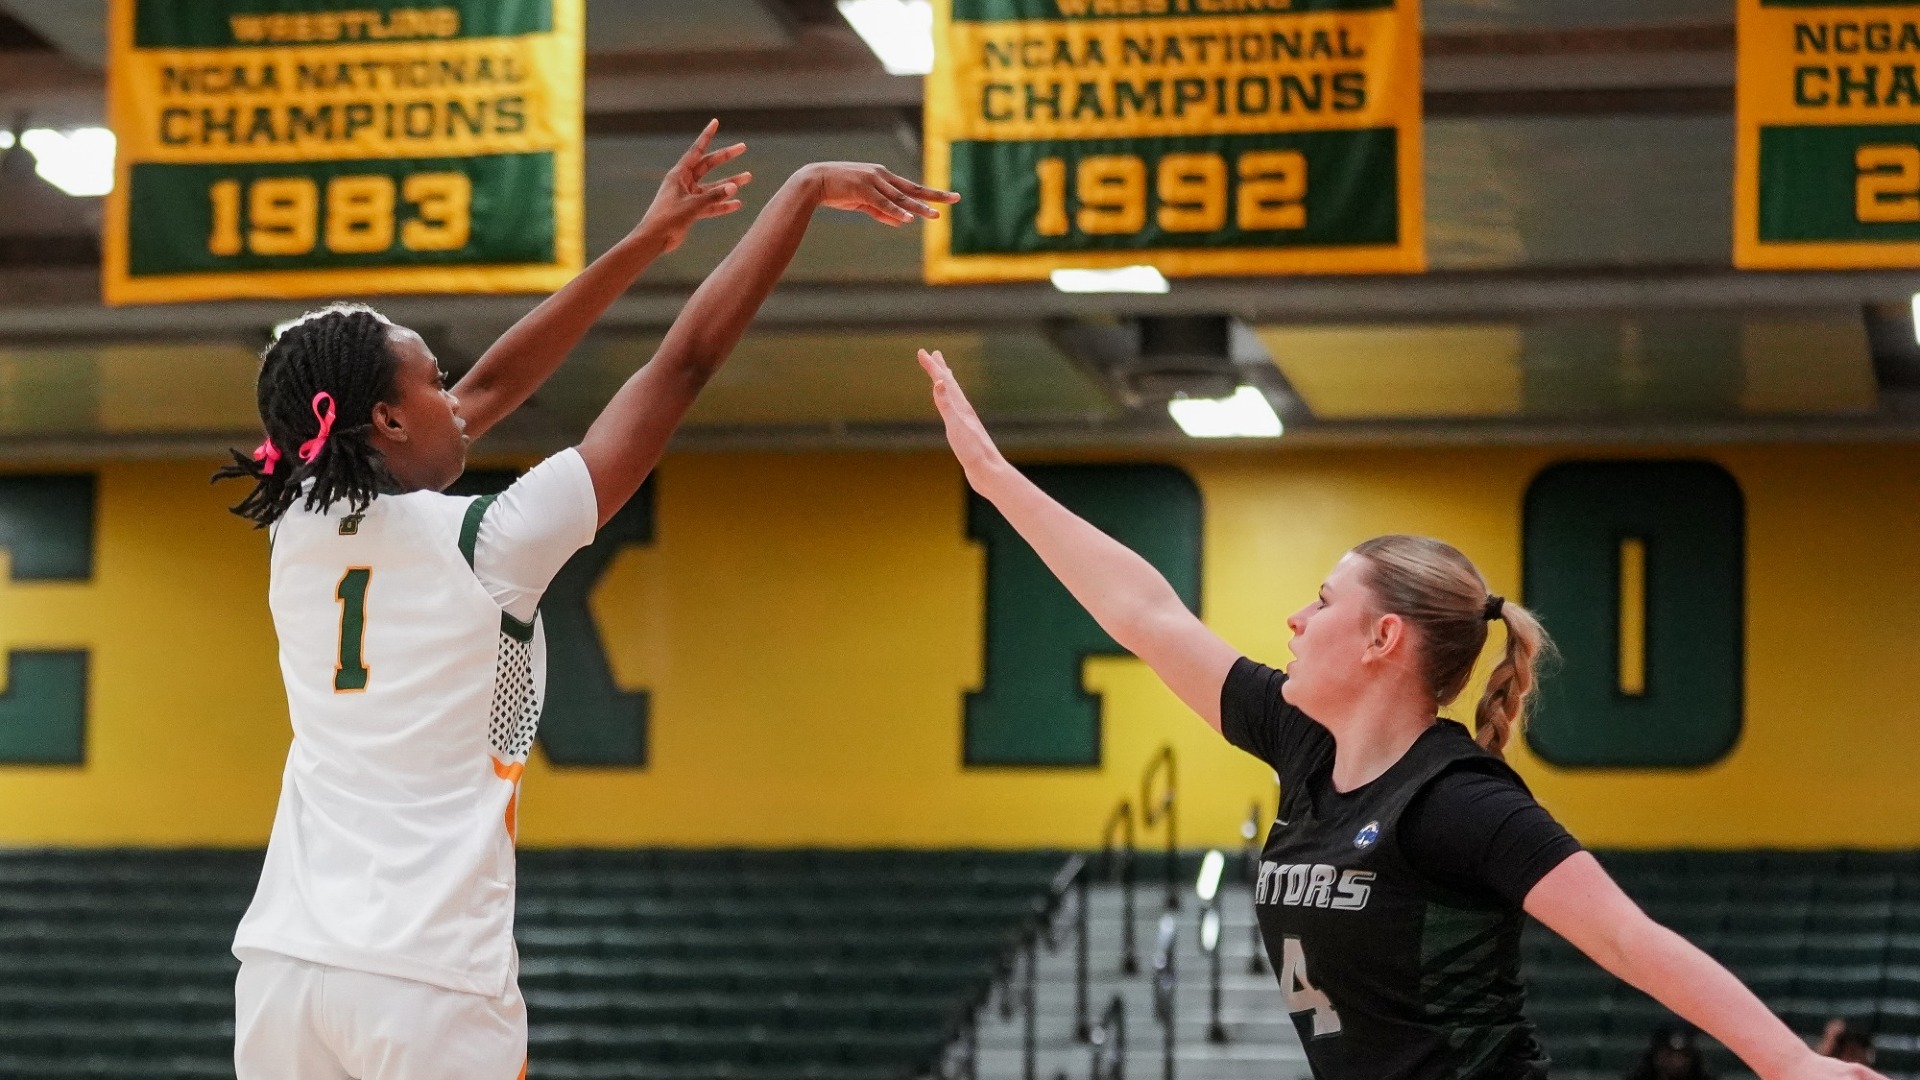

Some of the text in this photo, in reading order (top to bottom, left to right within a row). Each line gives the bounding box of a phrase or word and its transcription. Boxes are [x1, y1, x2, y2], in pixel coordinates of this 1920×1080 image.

[162, 56, 528, 95] NCAA NATIONAL
[984, 28, 1367, 69] NCAA NATIONAL
[160, 96, 527, 146] CHAMPIONS
[981, 72, 1369, 122] CHAMPIONS
[208, 172, 471, 256] 1983
[1035, 150, 1308, 236] 1992
[333, 565, 373, 694] 1
[1280, 933, 1342, 1040] 4
